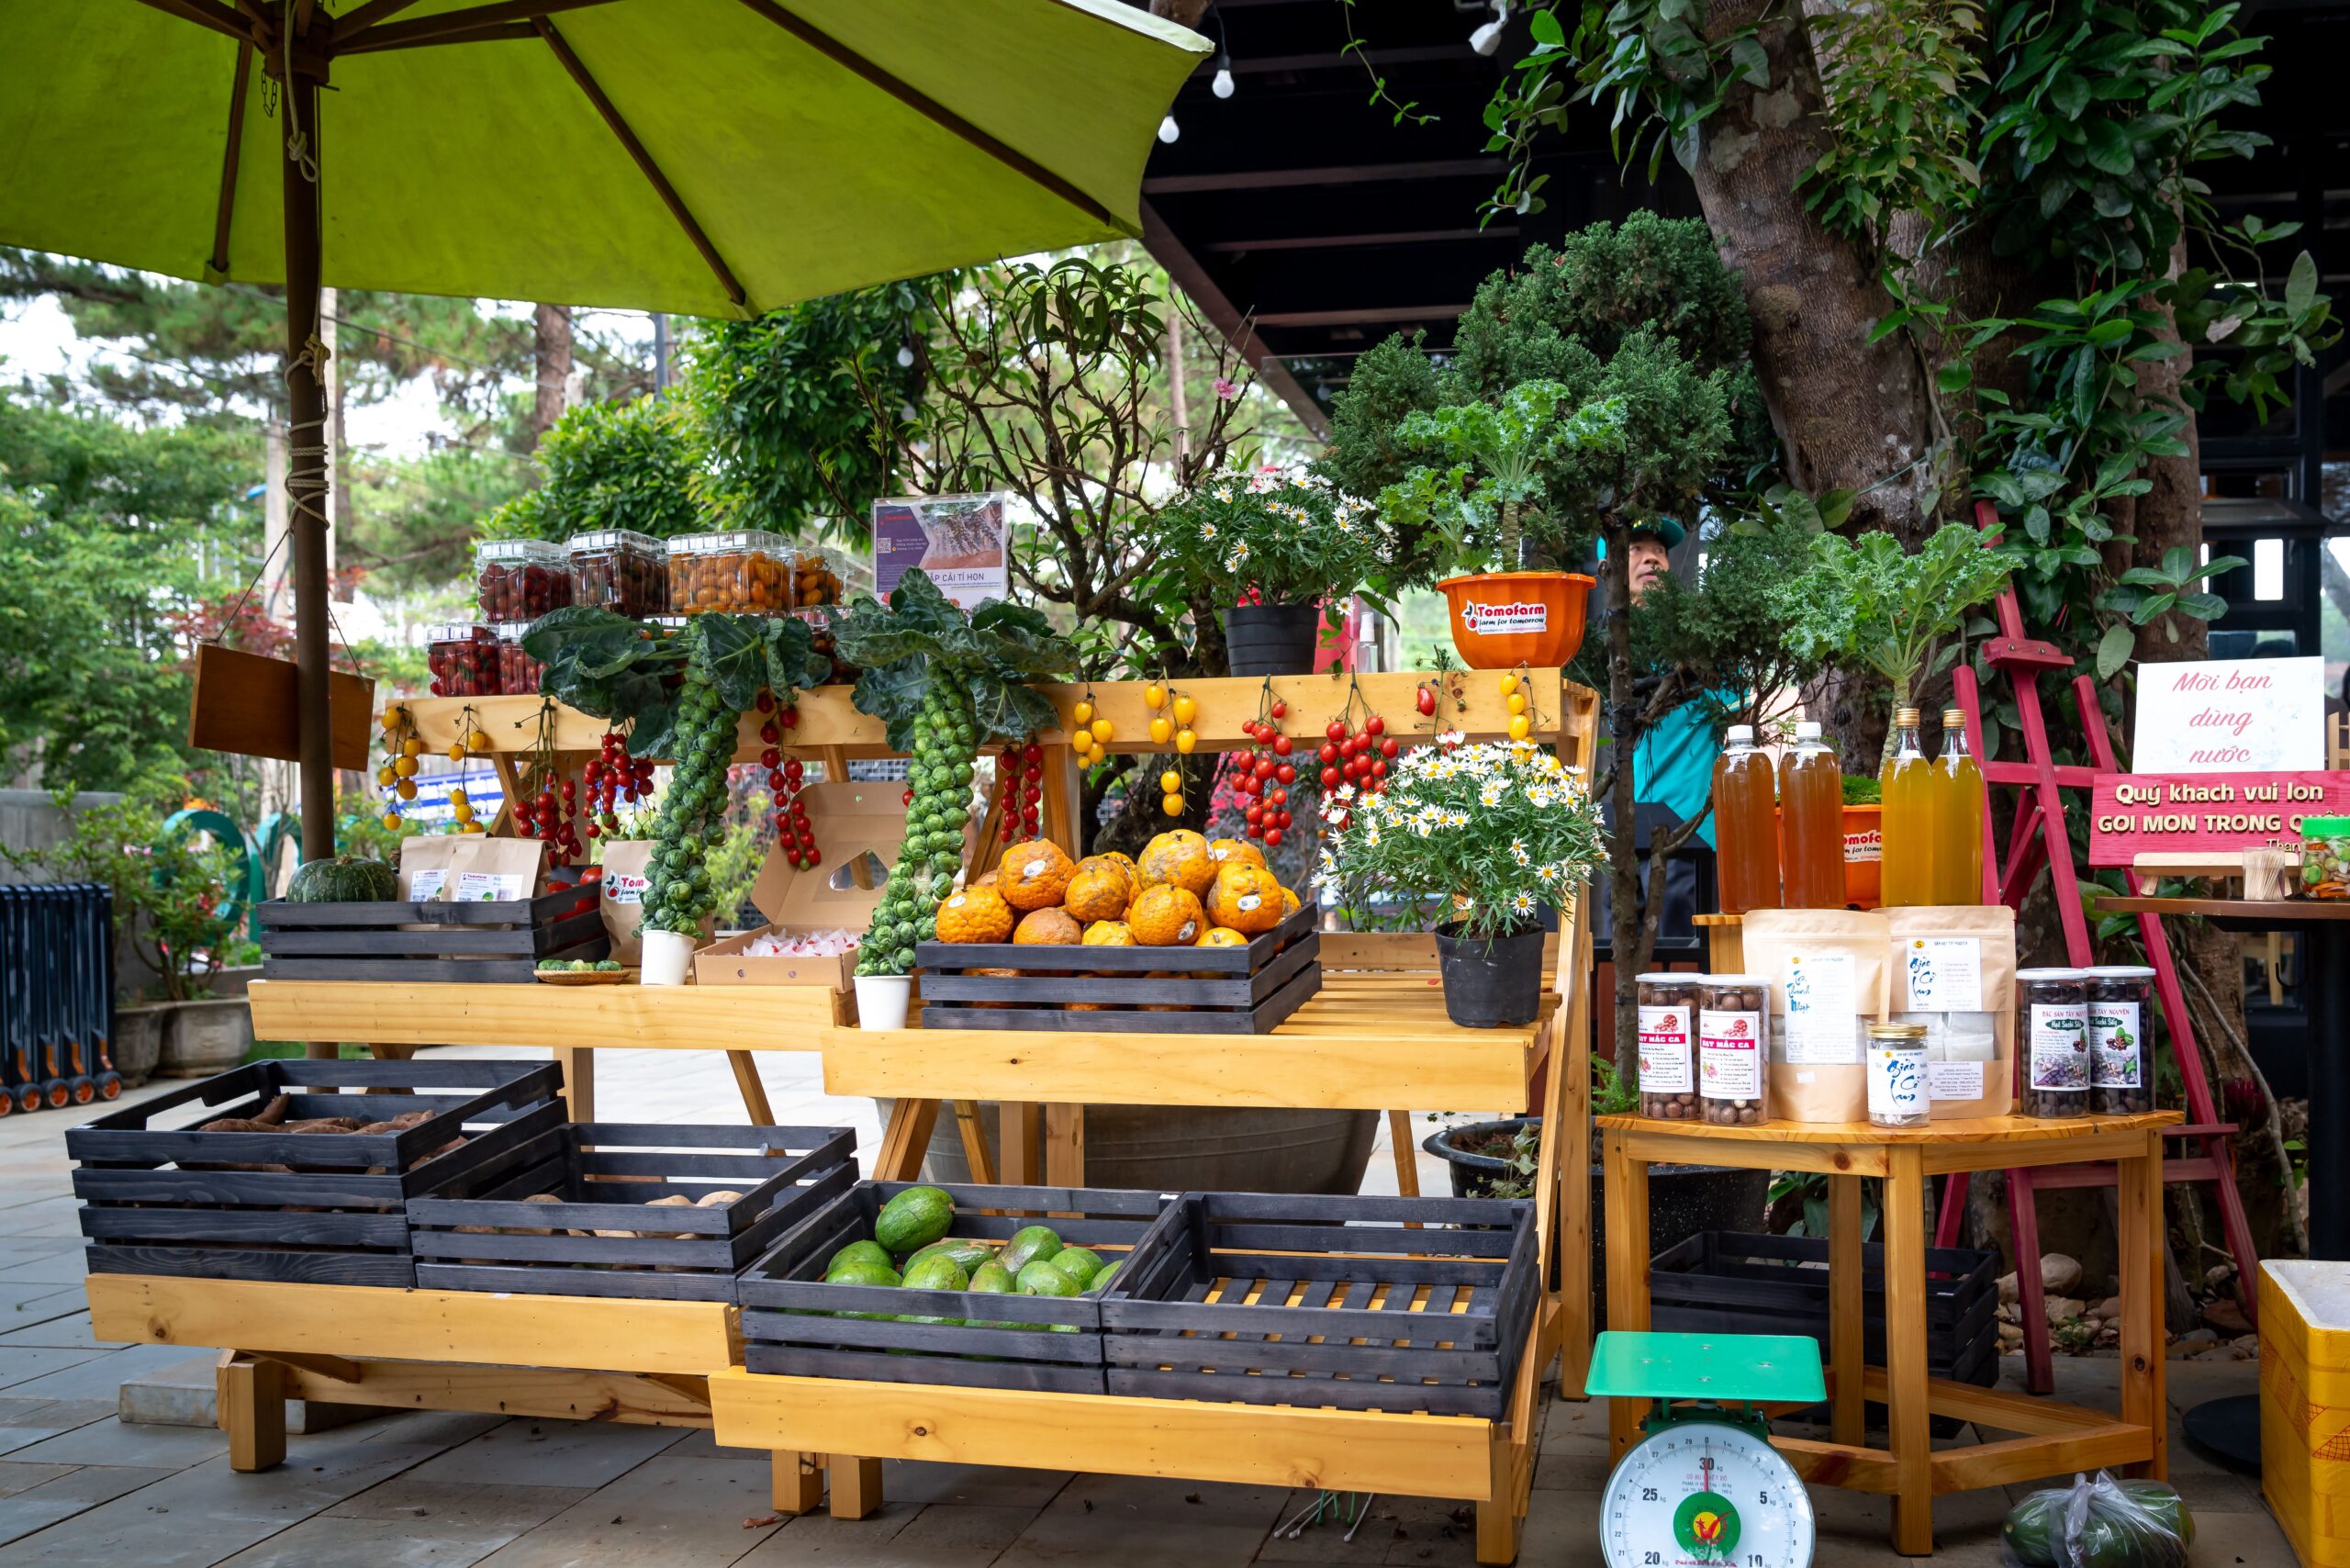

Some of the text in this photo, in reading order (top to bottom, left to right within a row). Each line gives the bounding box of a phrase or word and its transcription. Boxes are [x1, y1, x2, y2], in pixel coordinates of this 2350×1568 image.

[957, 571, 966, 581] TÍ
[1477, 605, 1544, 617] Tomofarm
[2172, 669, 2273, 694] Mời bạn
[2189, 707, 2254, 736] dùng
[2189, 745, 2252, 763] nước
[2115, 782, 2324, 807] Quý khach vui lon
[2098, 815, 2137, 833] GOI
[2143, 815, 2197, 833] MON
[2204, 814, 2282, 833] TRONG
[1699, 1457, 1714, 1471] 30
[1642, 1488, 1658, 1501] 25
[1760, 1491, 1768, 1505] 5
[1645, 1551, 1660, 1565] 20
[1747, 1554, 1762, 1568] 10
